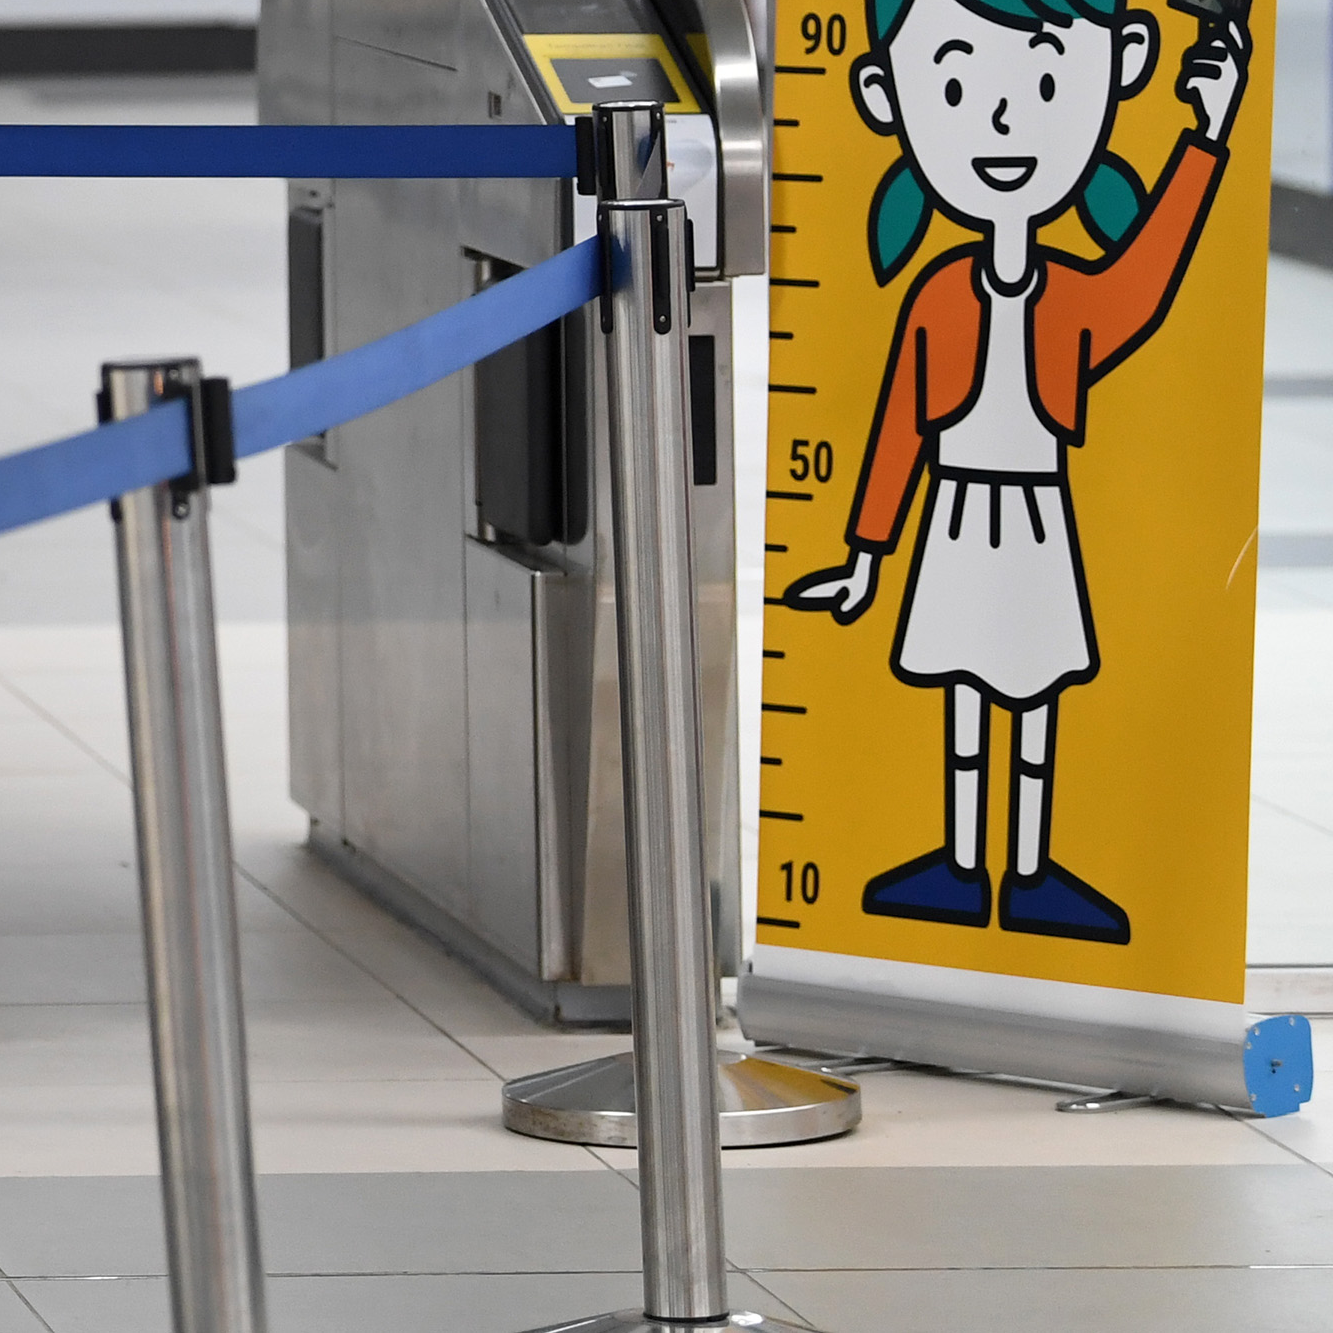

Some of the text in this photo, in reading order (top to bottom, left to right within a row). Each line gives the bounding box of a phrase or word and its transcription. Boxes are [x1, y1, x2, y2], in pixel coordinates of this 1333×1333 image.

[801, 12, 847, 56] 90
[790, 439, 833, 483] 50
[780, 860, 820, 905] 10
